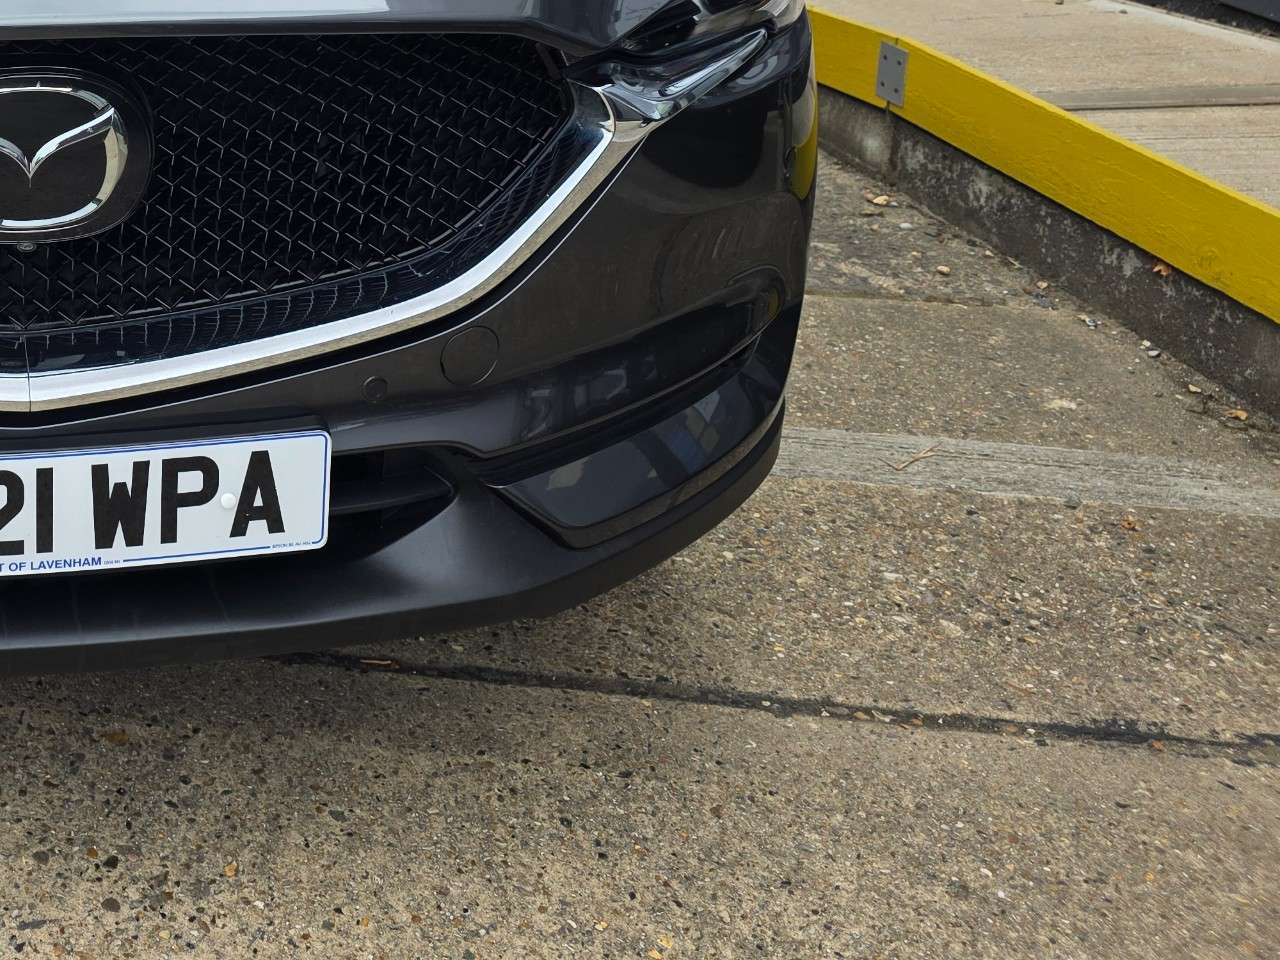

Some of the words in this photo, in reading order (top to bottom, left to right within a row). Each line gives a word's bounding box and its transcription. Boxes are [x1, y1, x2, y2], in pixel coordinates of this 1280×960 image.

[91, 450, 286, 550] WPA
[8, 561, 27, 572] OF
[30, 556, 102, 571] LAVENHAM
